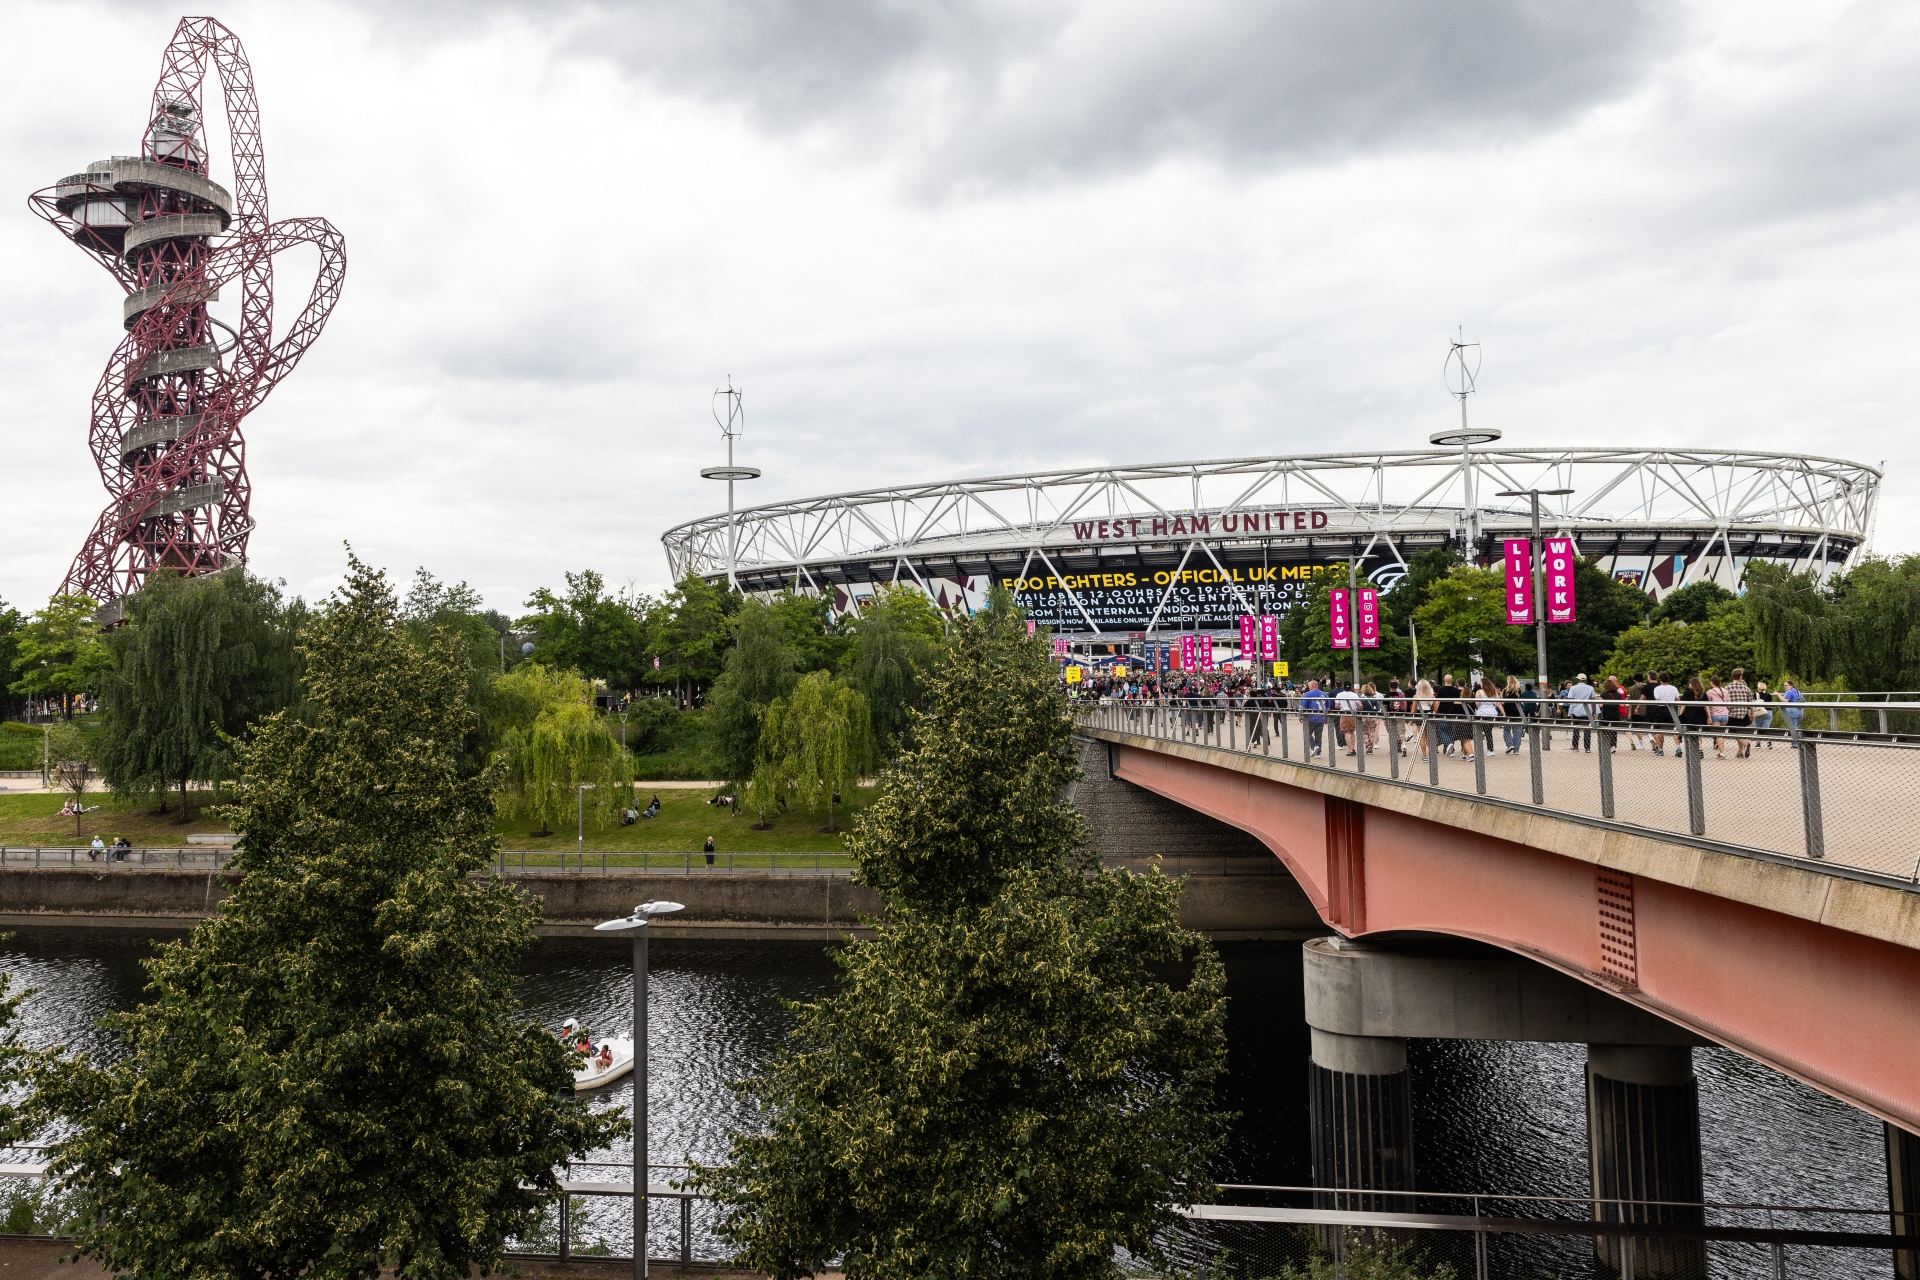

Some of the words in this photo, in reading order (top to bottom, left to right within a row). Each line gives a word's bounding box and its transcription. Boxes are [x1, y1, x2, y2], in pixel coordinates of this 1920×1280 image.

[1073, 519, 1141, 540] WEST
[1152, 515, 1210, 536] HAM
[1222, 511, 1328, 532] UNITED
[1002, 576, 1043, 591] FOO
[1047, 572, 1137, 590] FIGHTERS
[1153, 569, 1245, 585] OFFICIAL
[1248, 567, 1278, 581] UK
[1281, 564, 1347, 579] MERC
[1512, 543, 1524, 605] LIVE
[1549, 542, 1567, 604] WORK
[1015, 590, 1083, 600] VAILABLE
[1171, 586, 1190, 596] TO
[1016, 599, 1034, 607] HE
[1039, 597, 1099, 607] LONDON
[1106, 594, 1180, 605] AQUATICS
[1027, 609, 1054, 617] ROM
[1057, 608, 1080, 616] HE
[1084, 606, 1142, 616] NTERNAL
[1146, 604, 1200, 614] LONDON
[1203, 602, 1257, 613] STADIUM
[1167, 615, 1193, 623] MERCH
[1335, 592, 1344, 635] PLAY
[1263, 617, 1272, 650] WORK
